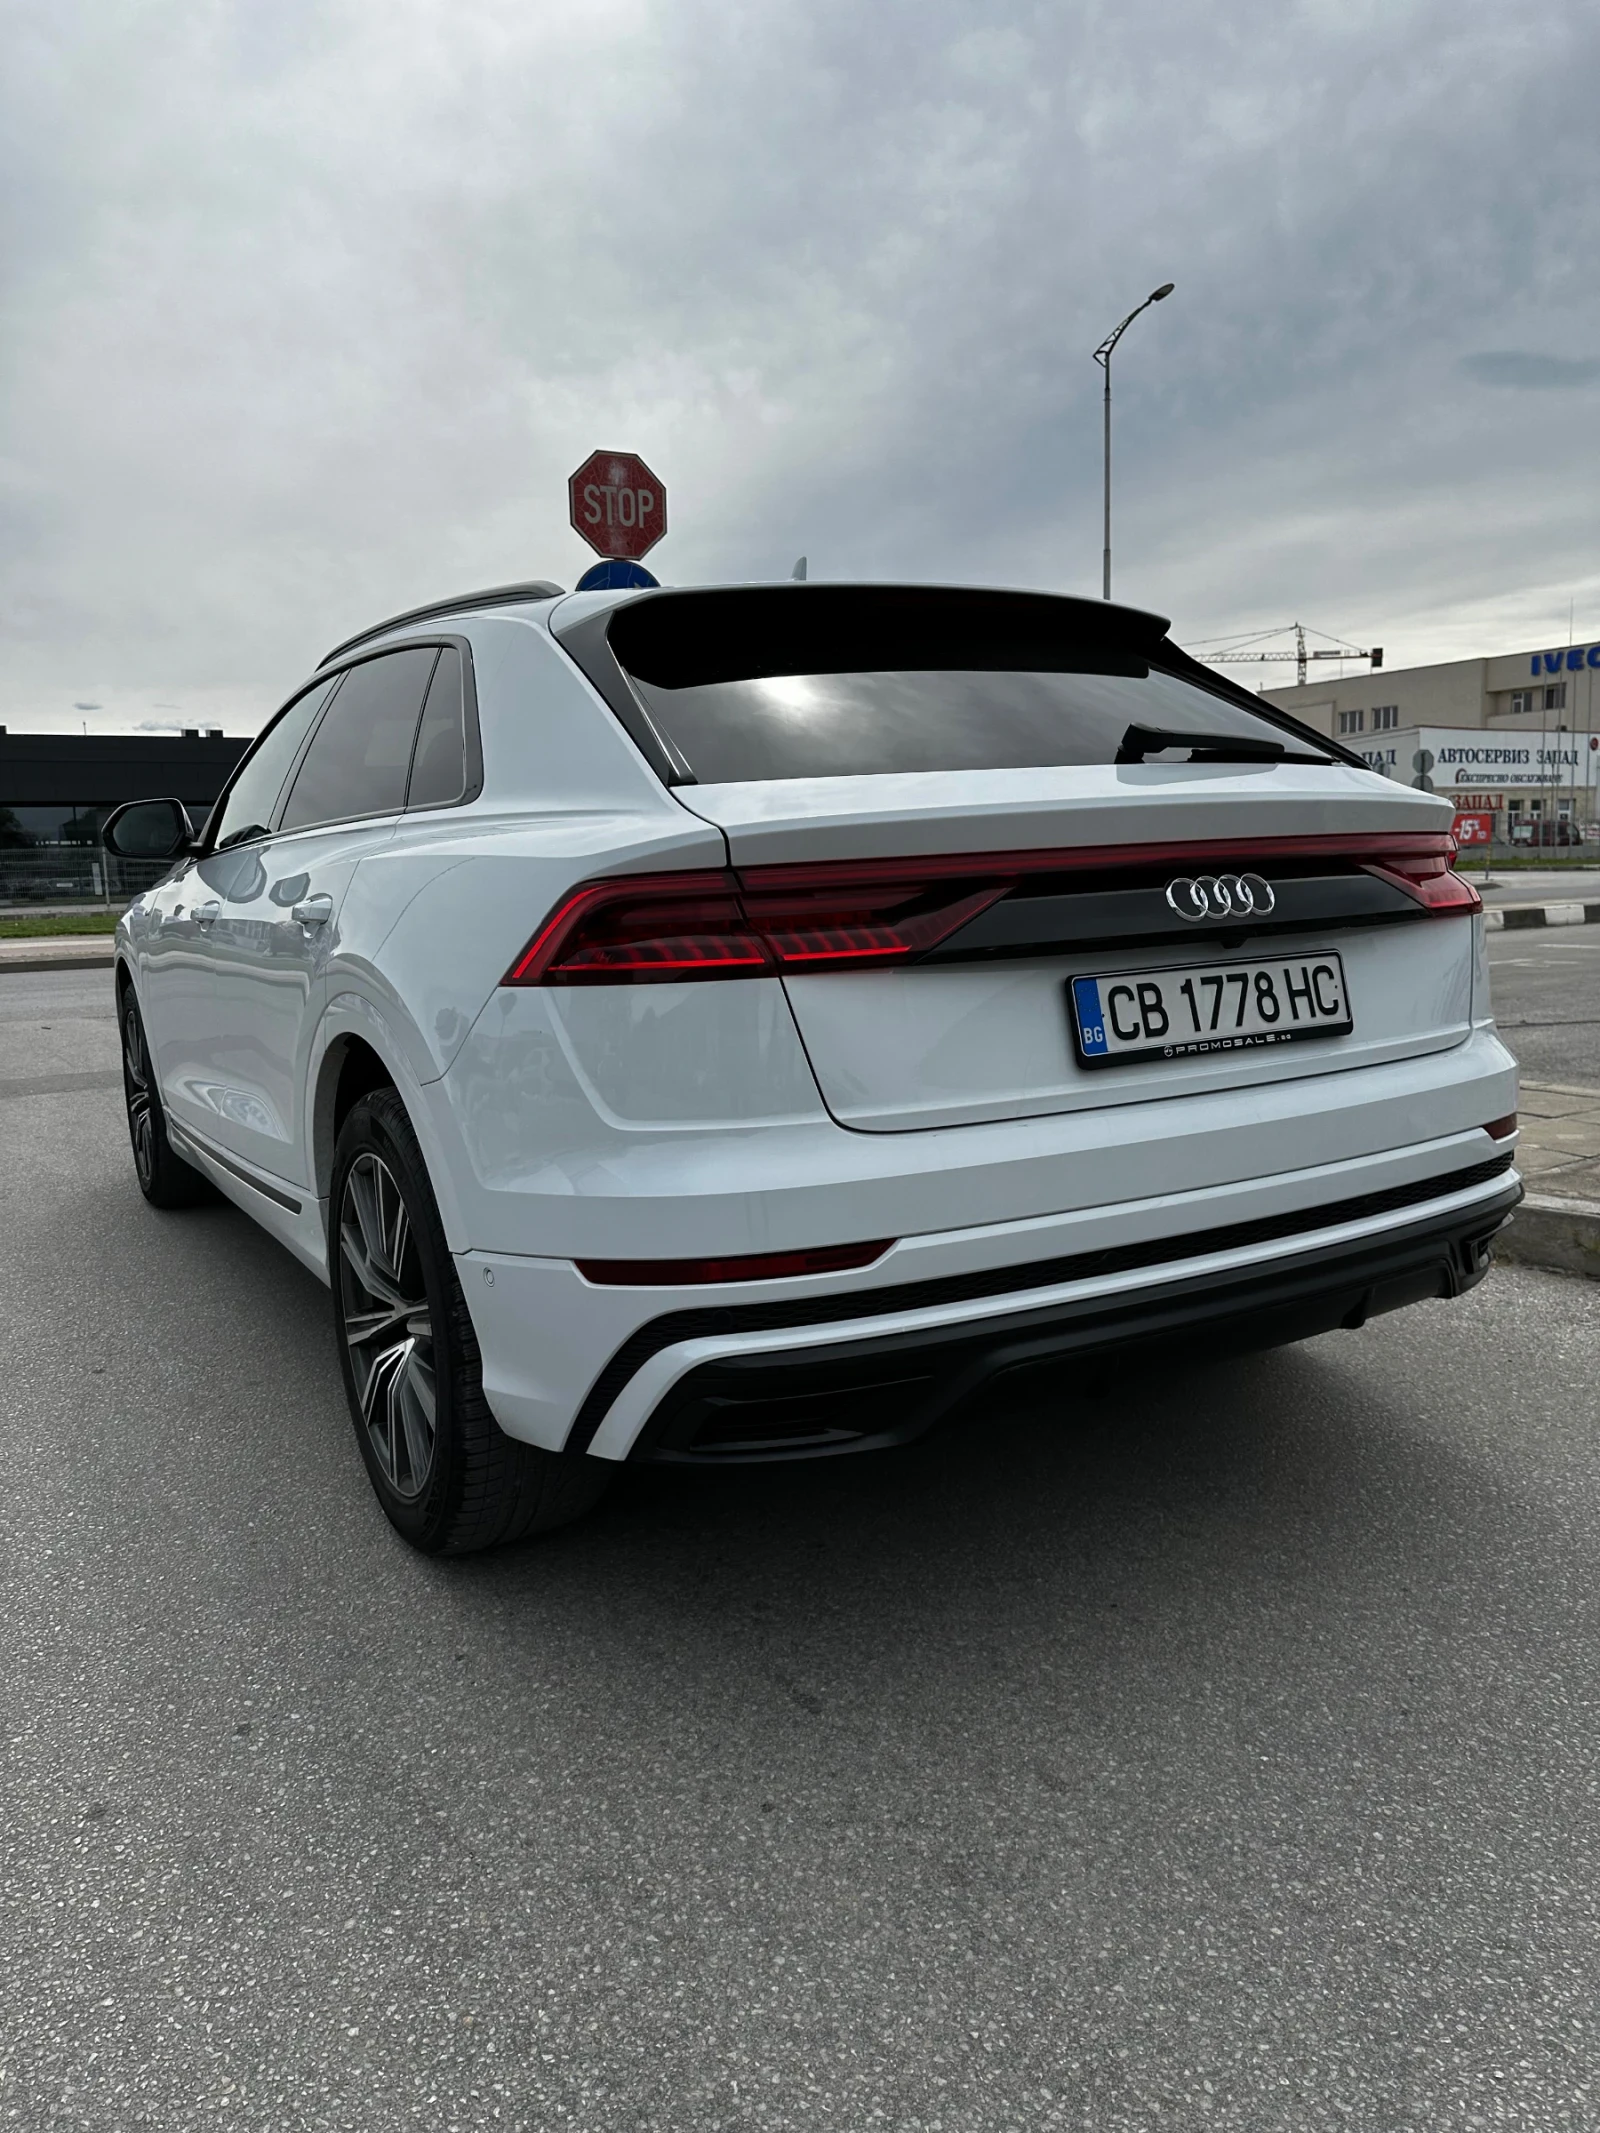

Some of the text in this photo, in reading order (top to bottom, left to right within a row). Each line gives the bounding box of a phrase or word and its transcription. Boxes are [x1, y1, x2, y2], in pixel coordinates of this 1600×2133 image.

[583, 484, 655, 529] STOP
[1531, 646, 1600, 677] IVEC
[1438, 748, 1579, 766] АВТОСЕРВИЗ ЗАПАД
[1108, 964, 1340, 1041] CB 1778 HC
[1083, 1026, 1103, 1044] BG
